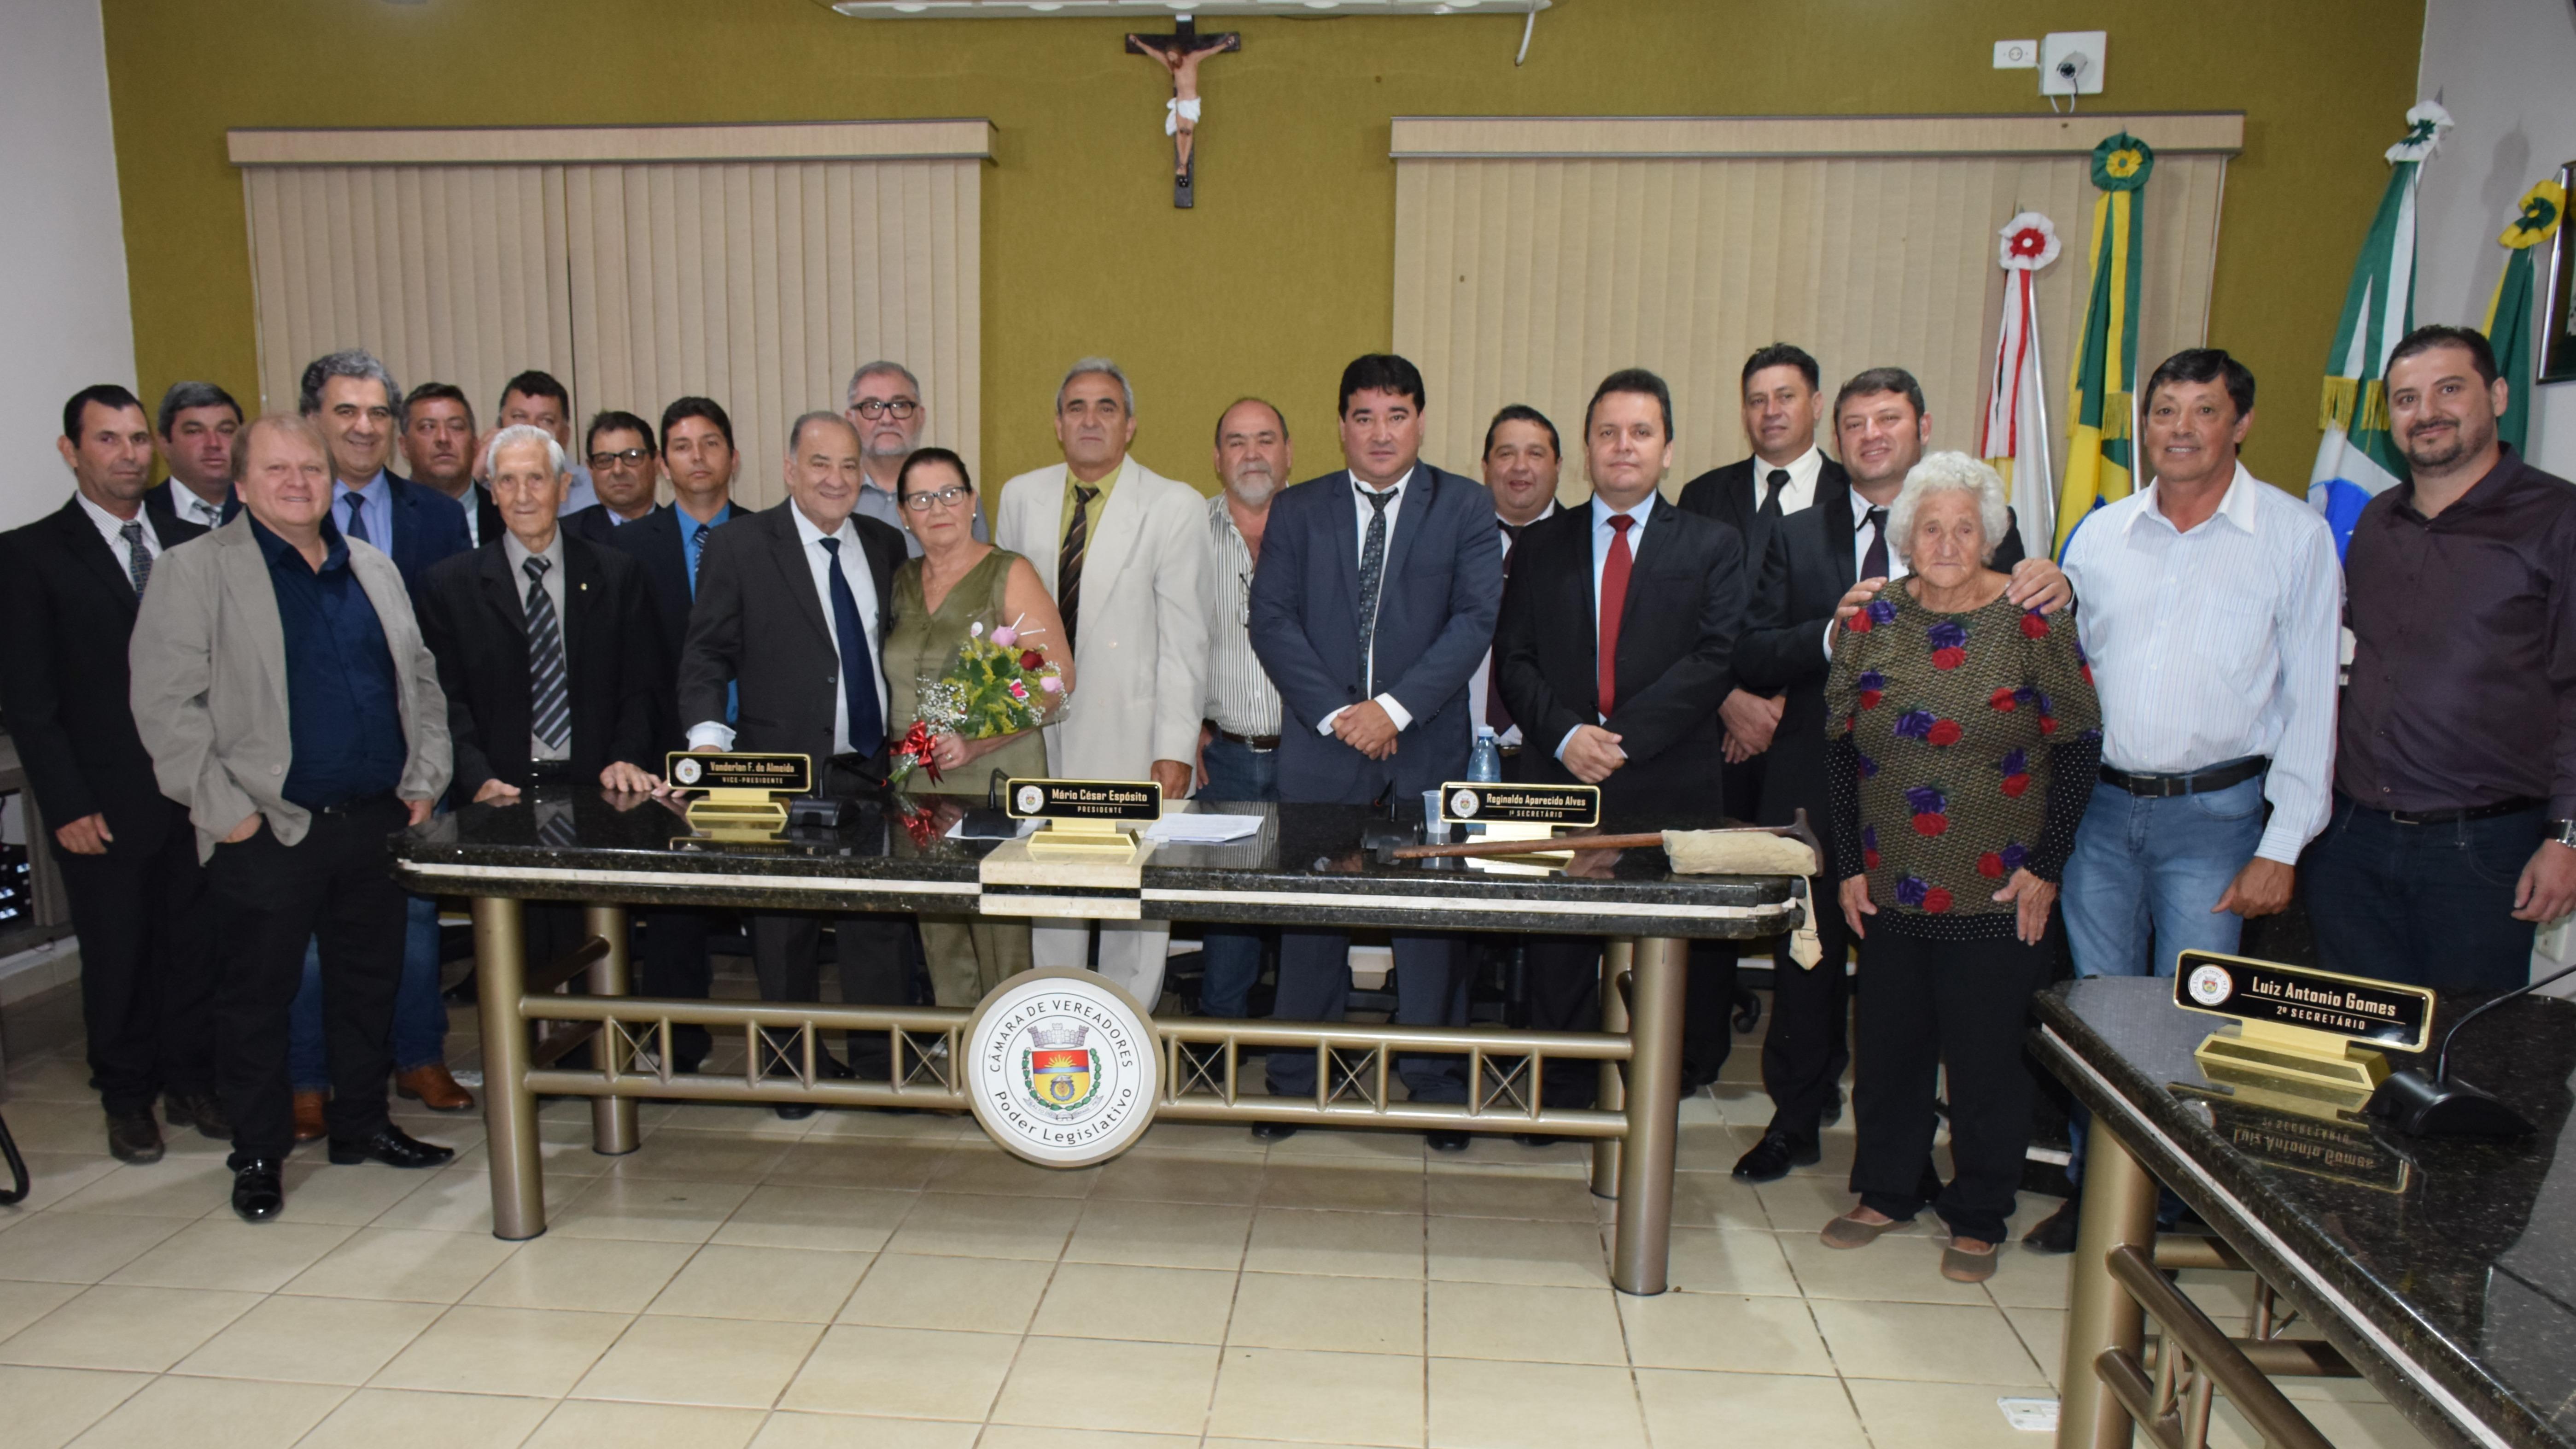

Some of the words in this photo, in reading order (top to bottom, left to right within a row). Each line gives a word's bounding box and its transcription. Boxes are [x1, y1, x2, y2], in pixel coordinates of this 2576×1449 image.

[748, 762, 755, 772] F.
[766, 763, 794, 772] Almeida
[1052, 788, 1077, 800] Mário
[1080, 789, 1107, 800] César
[1109, 790, 1147, 803] Espósito
[1487, 793, 1523, 805] Reginaldo
[1525, 794, 1564, 806] Aparecido
[1565, 796, 1586, 806] Alves
[2252, 976, 2282, 996] Luiz
[2284, 982, 2341, 1007] Antonio
[2345, 992, 2396, 1016] Gomes
[2290, 1008, 2365, 1030] SECRETÁRIO
[988, 1015, 1025, 1072] CÂMARA
[1026, 1002, 1046, 1017] DE
[1052, 1000, 1133, 1068] VEREADORES
[995, 1091, 1037, 1133] Poder
[1043, 1089, 1131, 1144] Legislativo
